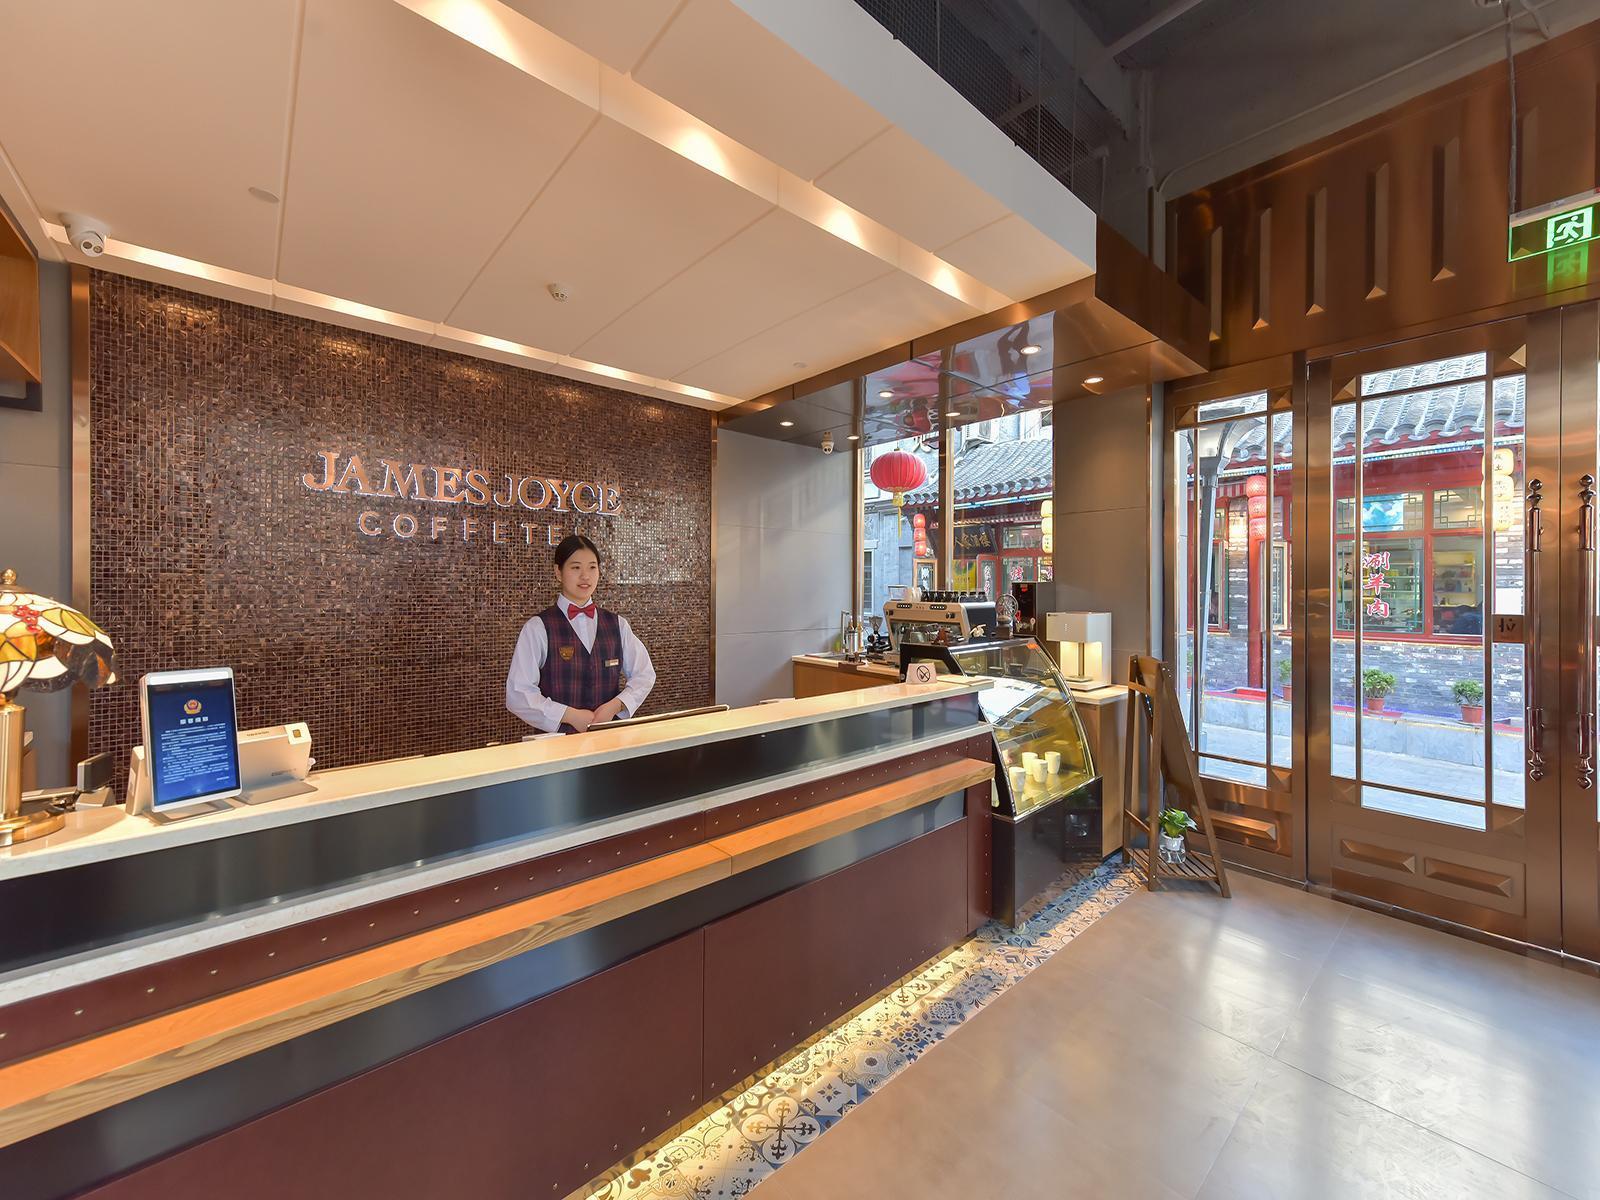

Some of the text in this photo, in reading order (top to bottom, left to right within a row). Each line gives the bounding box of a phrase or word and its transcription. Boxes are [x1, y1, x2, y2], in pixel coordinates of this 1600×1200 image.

[302, 451, 622, 516] JAMES JOYCE
[1363, 551, 1391, 618] 涮羊肉
